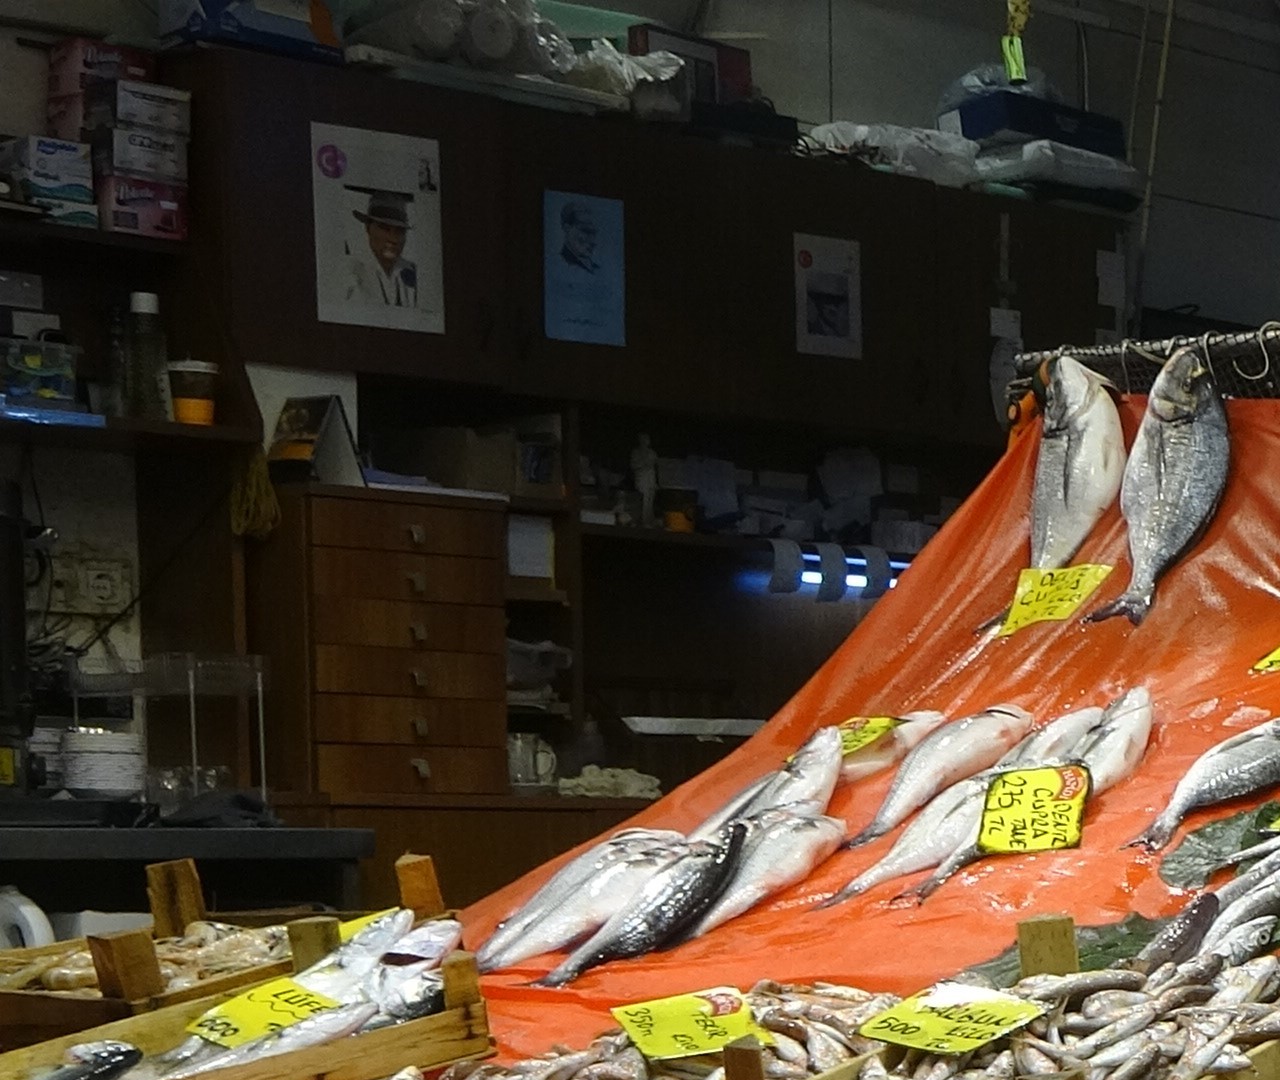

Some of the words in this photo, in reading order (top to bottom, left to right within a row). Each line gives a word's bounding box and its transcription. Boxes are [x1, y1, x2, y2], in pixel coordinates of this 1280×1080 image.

[998, 776, 1027, 808] 275
[989, 816, 1005, 835] TL
[272, 989, 331, 1014] LÜFE
[873, 1016, 921, 1035] 500
